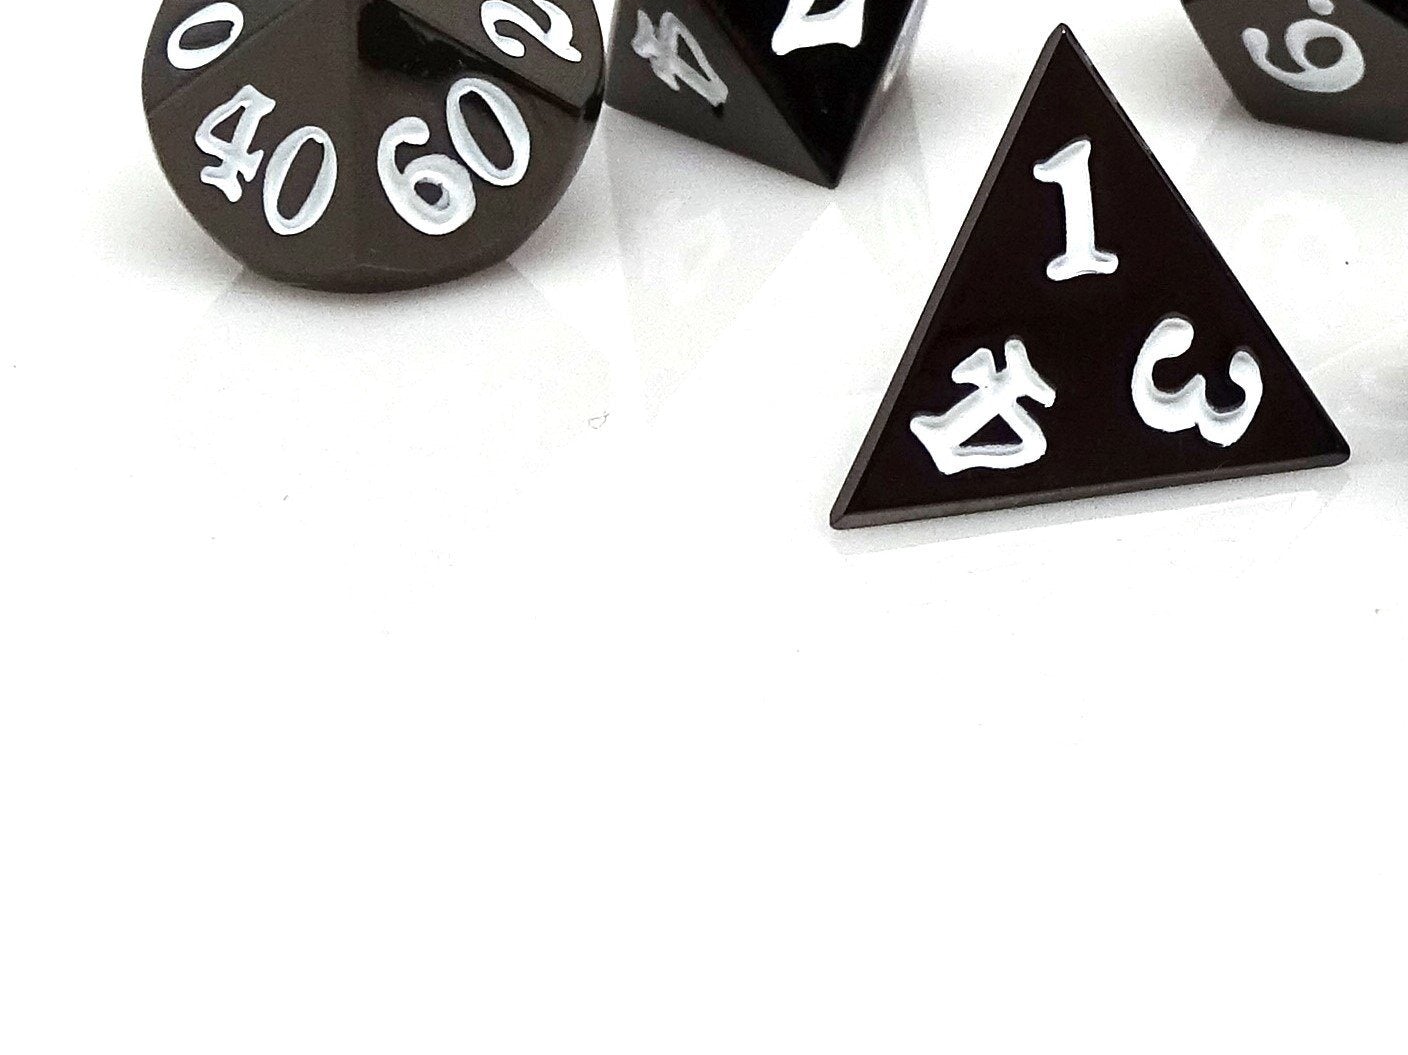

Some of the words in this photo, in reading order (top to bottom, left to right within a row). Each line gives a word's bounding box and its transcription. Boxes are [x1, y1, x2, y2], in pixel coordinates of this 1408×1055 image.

[631, 9, 728, 107] 4
[194, 85, 338, 235] 40
[377, 77, 530, 235] 60
[1033, 139, 1119, 281] 1
[910, 339, 1056, 475] 4
[1131, 317, 1263, 447] 3
